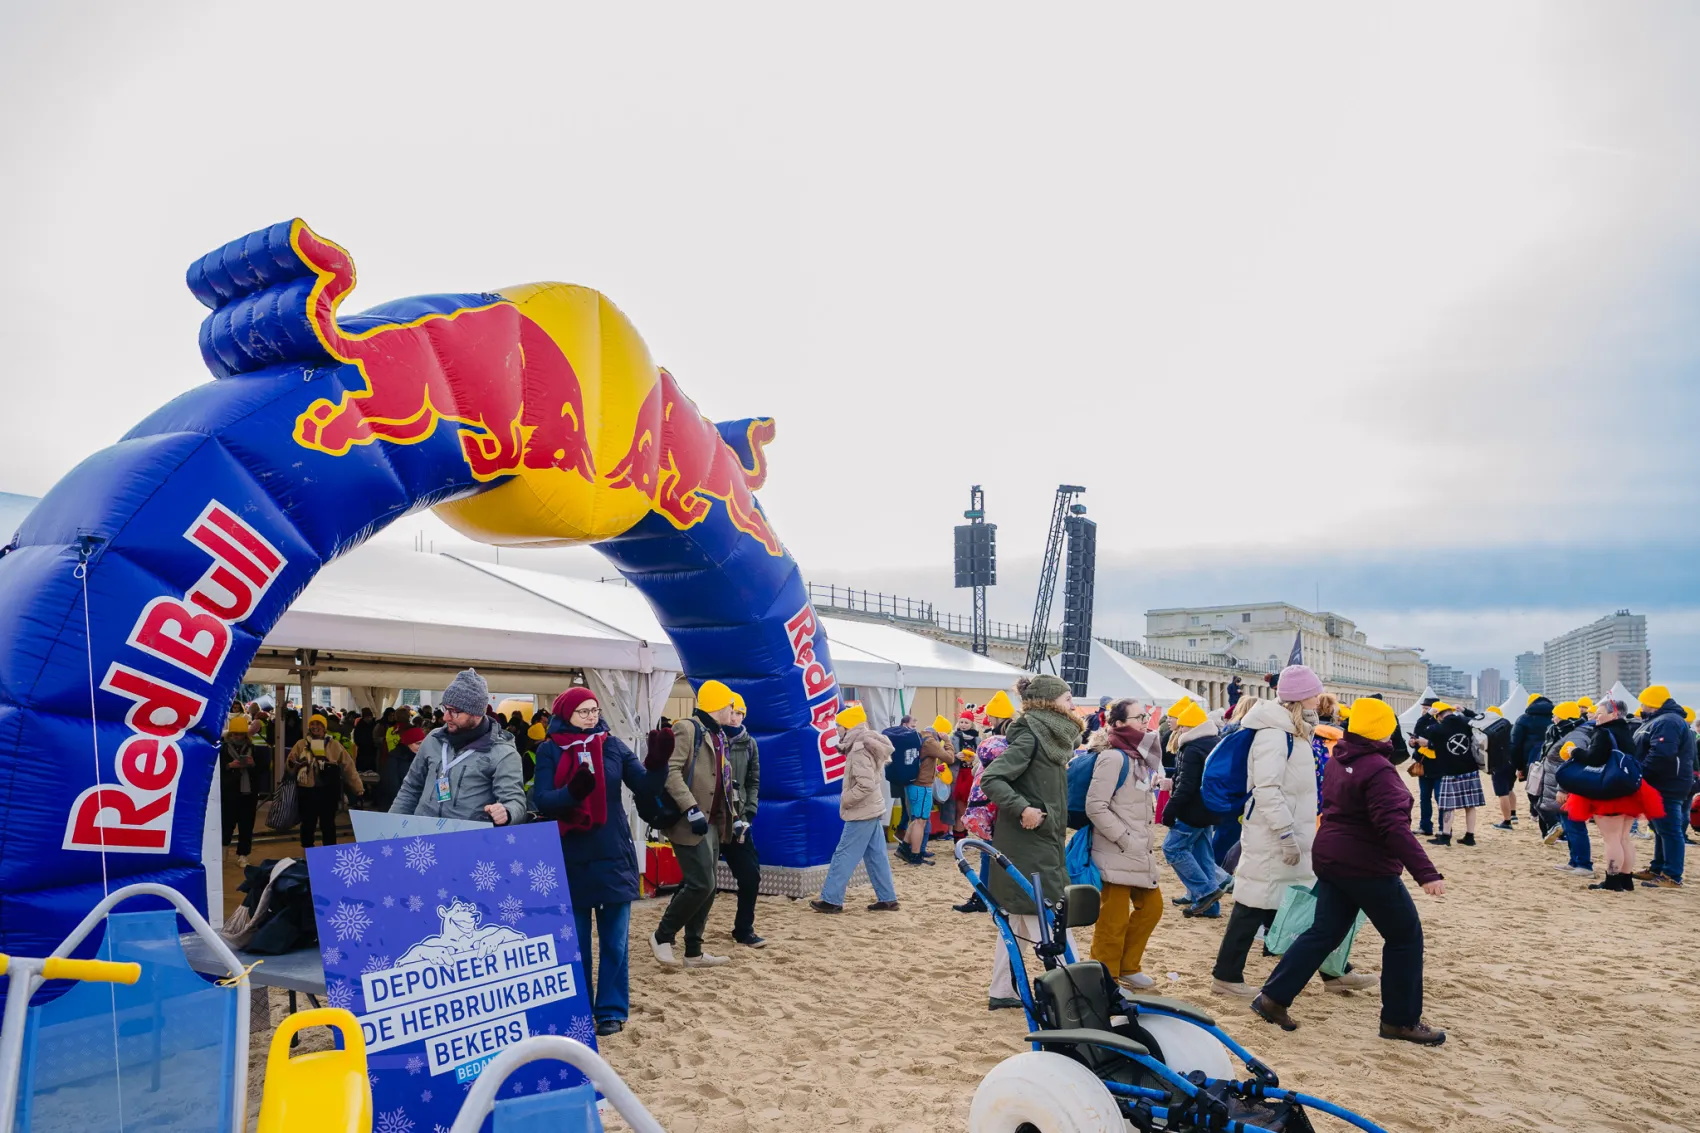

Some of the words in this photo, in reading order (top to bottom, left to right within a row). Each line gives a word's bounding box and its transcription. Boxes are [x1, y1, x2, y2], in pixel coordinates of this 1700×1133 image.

[135, 507, 282, 678] Bull
[787, 604, 836, 697] Red
[71, 669, 203, 849] Red
[360, 1016, 395, 1046] DE
[401, 971, 570, 1036] HERBRUIKBARE
[371, 954, 499, 1002] DEPONEER
[504, 942, 551, 971] HIER
[434, 1021, 523, 1066] BEKERS
